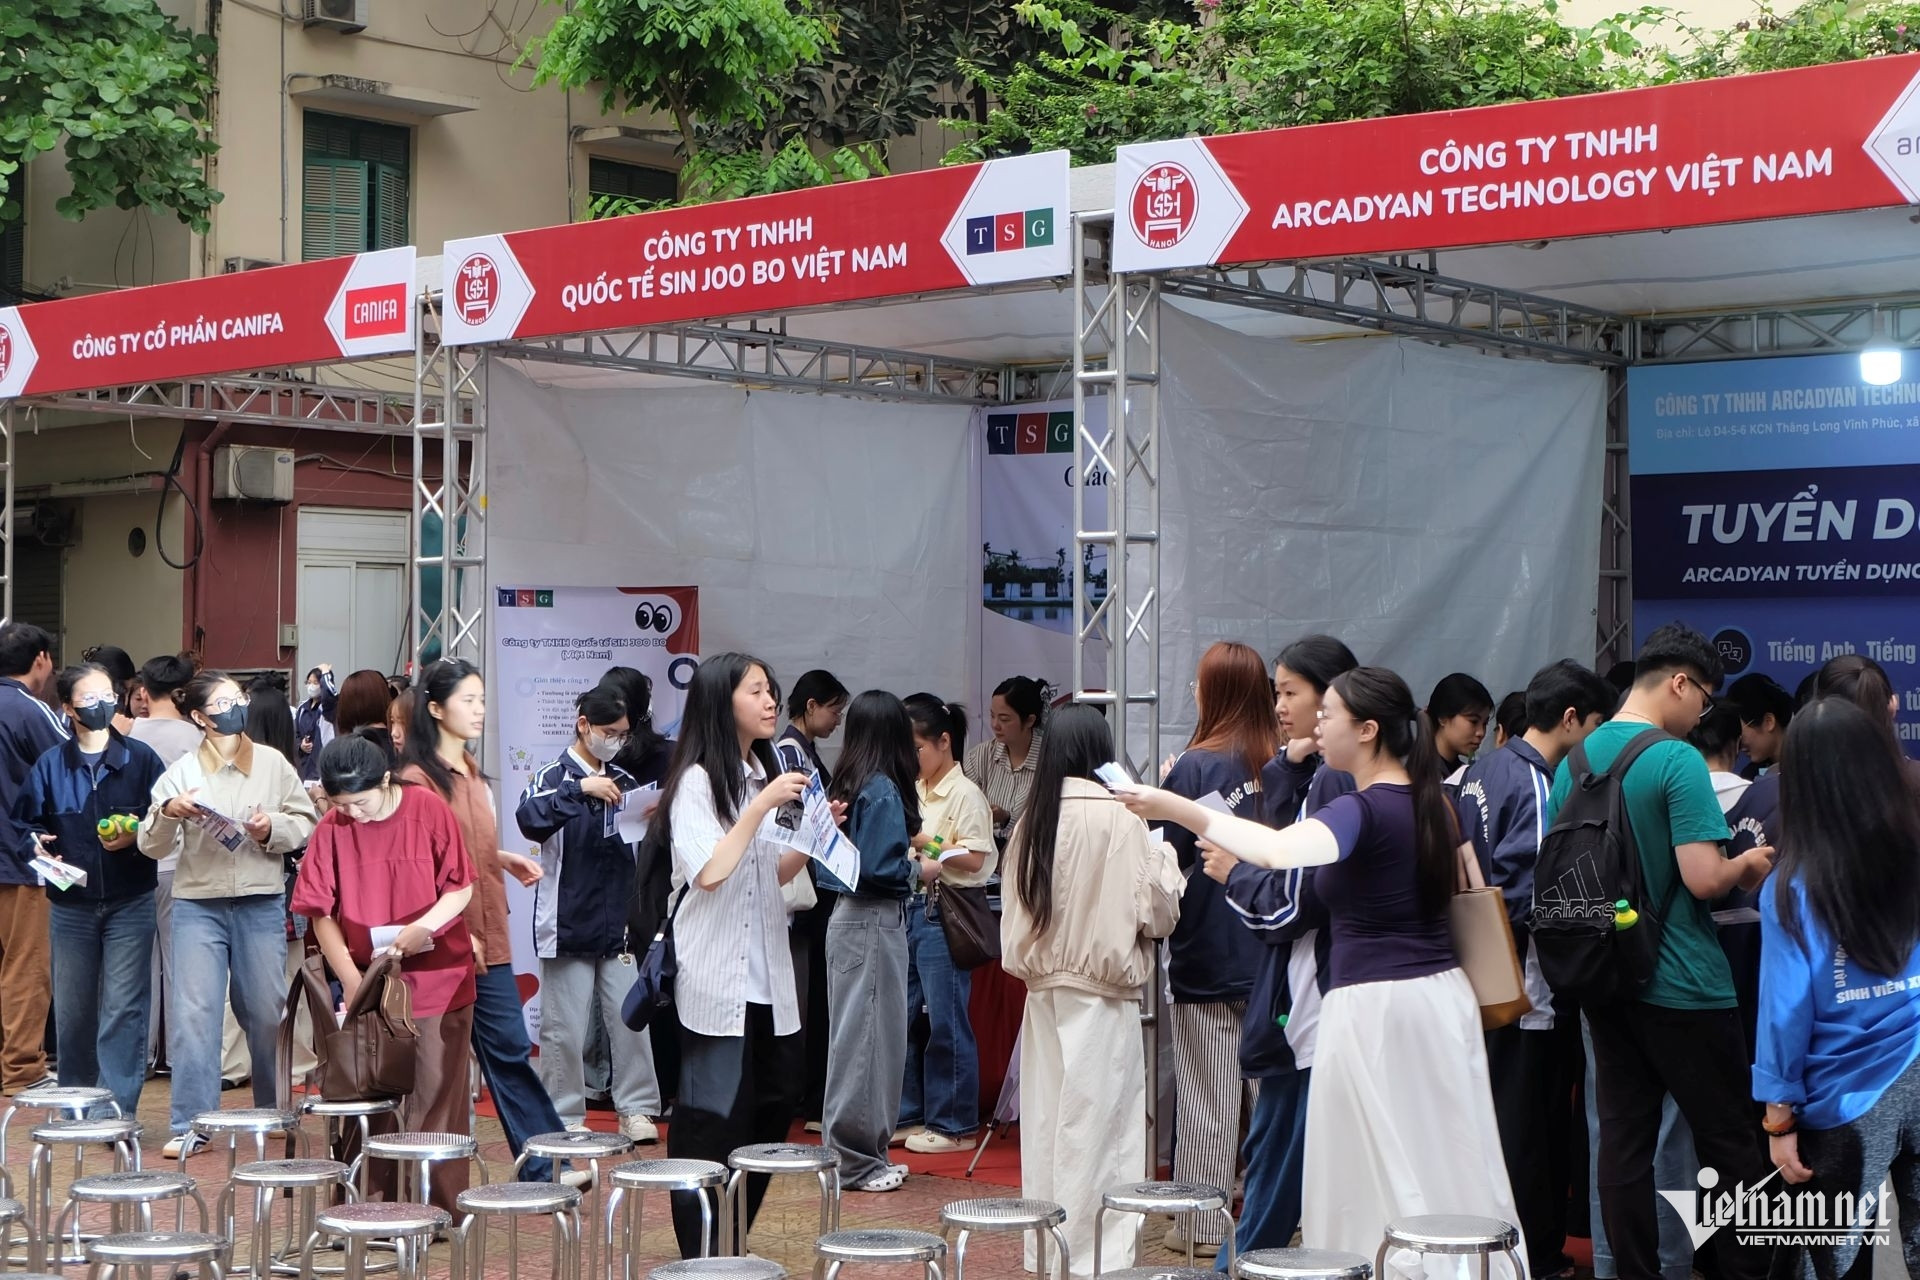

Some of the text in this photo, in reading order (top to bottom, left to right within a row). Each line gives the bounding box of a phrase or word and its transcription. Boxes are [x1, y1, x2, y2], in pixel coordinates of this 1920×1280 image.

[1420, 123, 1658, 175] CÔNG TY TNHH
[1271, 147, 1833, 229] ARCADYAN TECHNOLOGY VIỆT NAM
[643, 216, 812, 261] CÔNG TY TNHH
[1149, 237, 1176, 249] HANOI
[561, 242, 907, 312] QUỐC TẾ SIN JOO BO VIỆT NAM
[353, 298, 397, 325] CANIFA
[72, 312, 284, 360] CÔNG TY CỔ PHẦN CANIFA
[1655, 391, 1698, 417] CÔNG
[1702, 393, 1720, 415] TY
[1724, 391, 1767, 414] TNHH
[1772, 386, 1857, 411] ARCADYAN
[1750, 423, 1773, 435] KCN
[1813, 421, 1841, 434] Long
[1871, 416, 1903, 430] Phúc,
[1681, 484, 1858, 545] TUYỂN
[1681, 566, 1790, 583] ARCADYAN
[1795, 558, 1861, 581] TUYỂN
[502, 637, 528, 648] Công
[529, 638, 540, 648] ty
[541, 638, 571, 647] TNHH
[571, 637, 598, 648] Quốc
[611, 638, 629, 647] SIN
[629, 638, 651, 647] JOO
[652, 638, 667, 647] BO
[1767, 637, 1815, 664] Tiếng
[1866, 637, 1916, 664] Tiếng
[1836, 987, 1871, 1004] SINH
[1872, 980, 1906, 998] VIÊN
